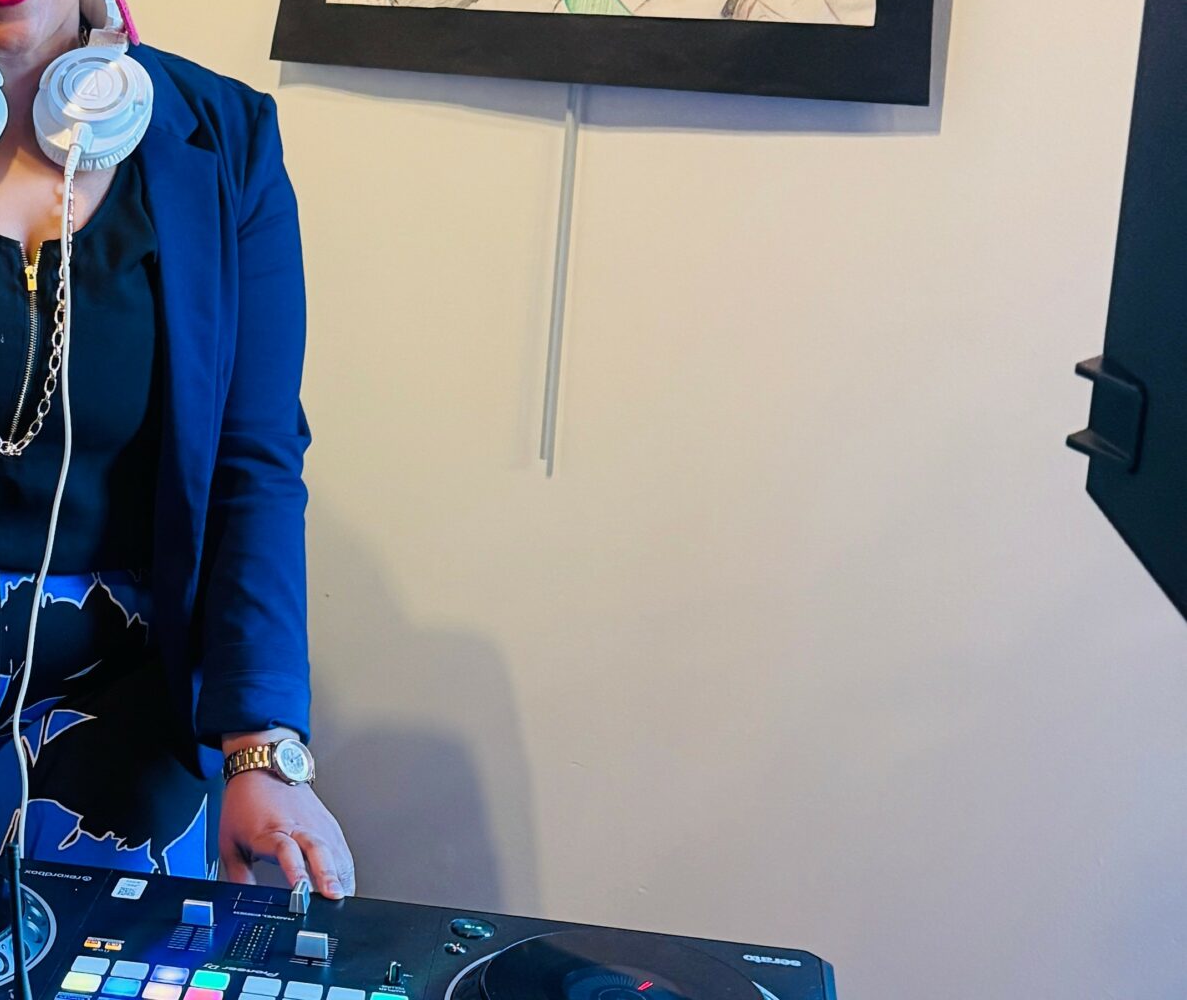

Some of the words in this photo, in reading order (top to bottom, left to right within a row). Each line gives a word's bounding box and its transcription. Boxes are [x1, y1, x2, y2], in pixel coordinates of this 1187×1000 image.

[24, 869, 82, 880] rekordbox
[742, 954, 802, 967] serato
[222, 966, 280, 977] Pioneer
